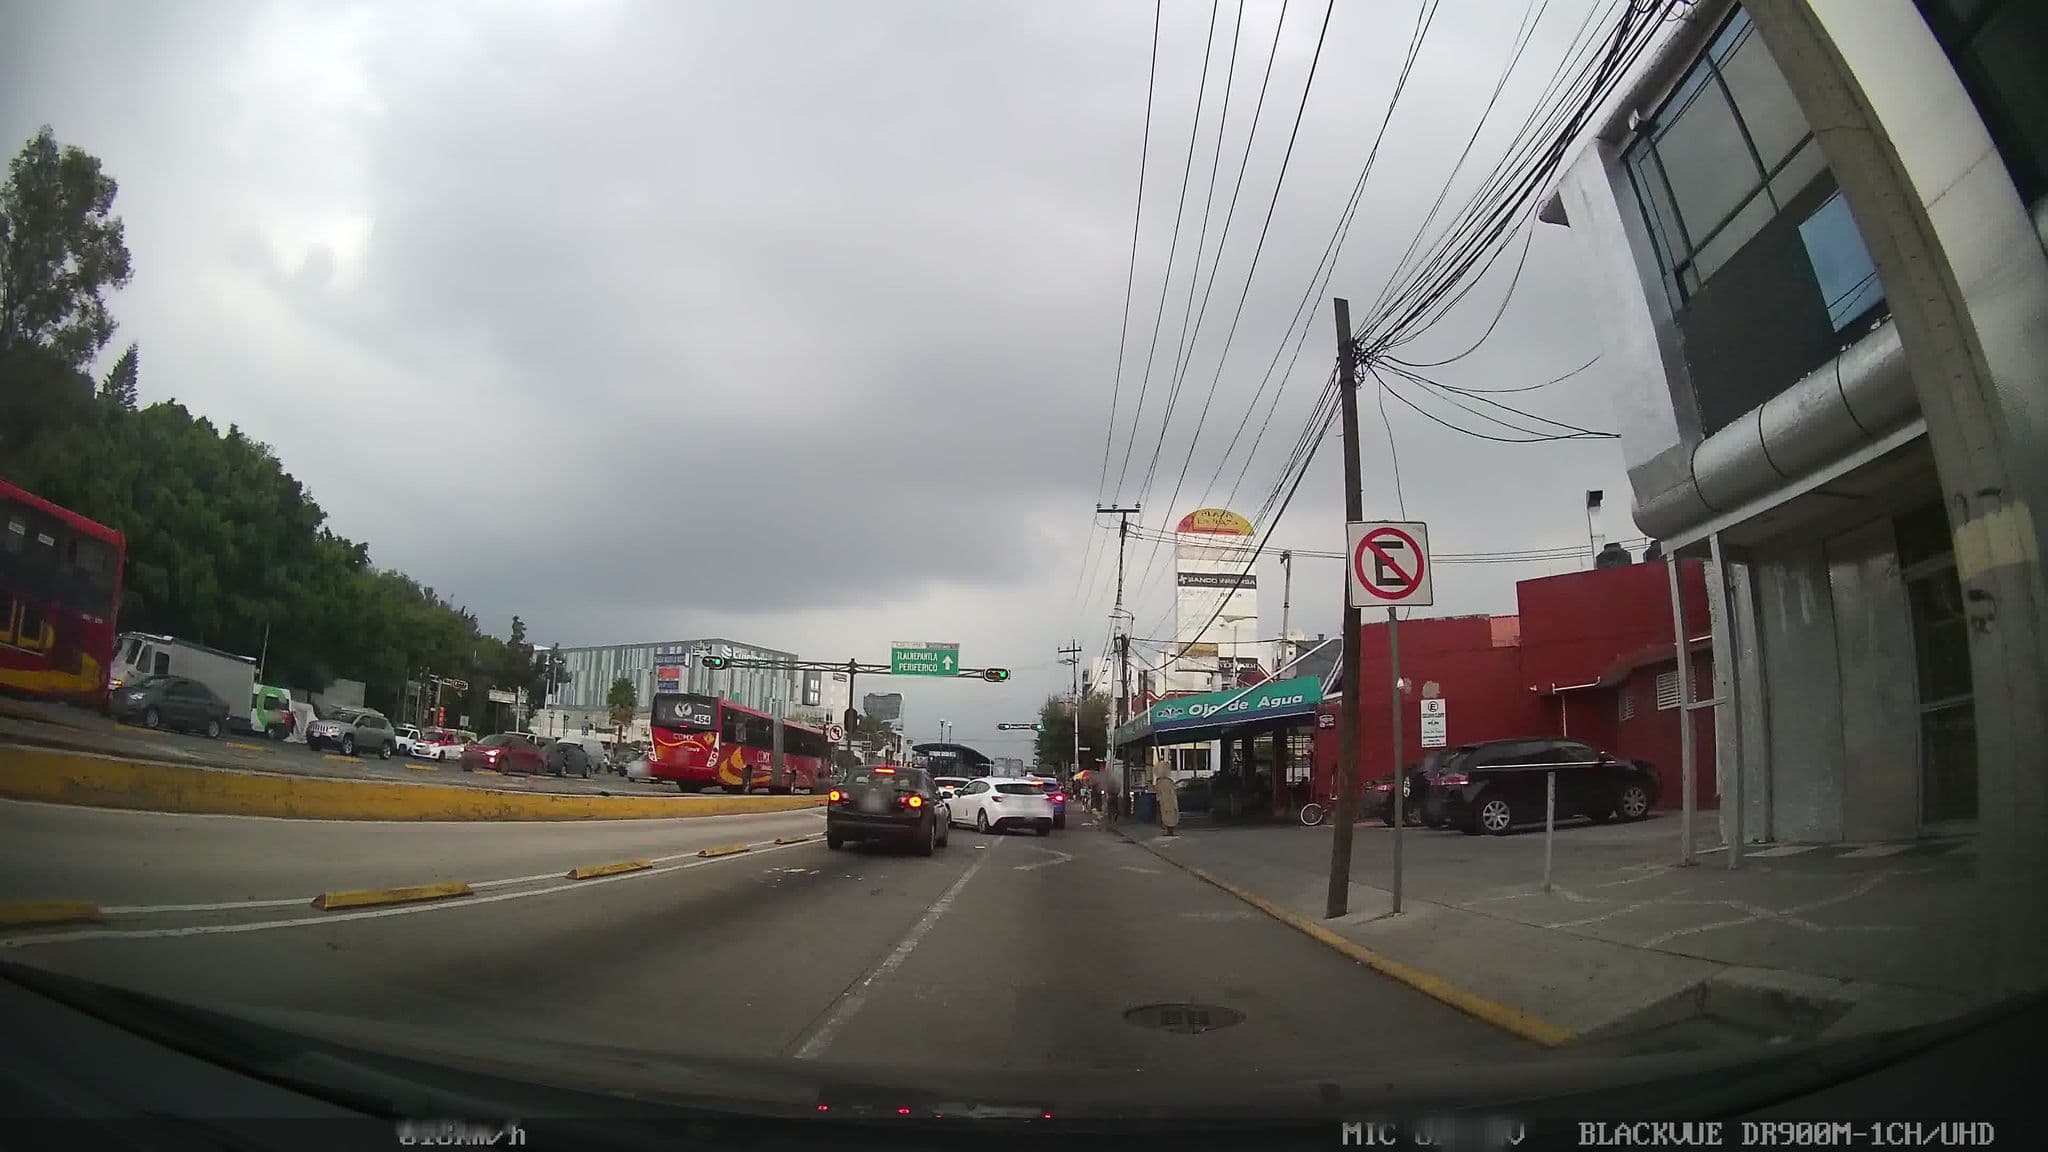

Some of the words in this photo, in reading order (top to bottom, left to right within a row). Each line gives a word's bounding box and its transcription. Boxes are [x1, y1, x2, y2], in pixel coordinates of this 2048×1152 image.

[1188, 576, 1217, 584] BANCO
[899, 662, 938, 672] PERIFERICO
[1227, 700, 1249, 711] de
[1257, 695, 1303, 708] Agua
[695, 714, 710, 723] 454
